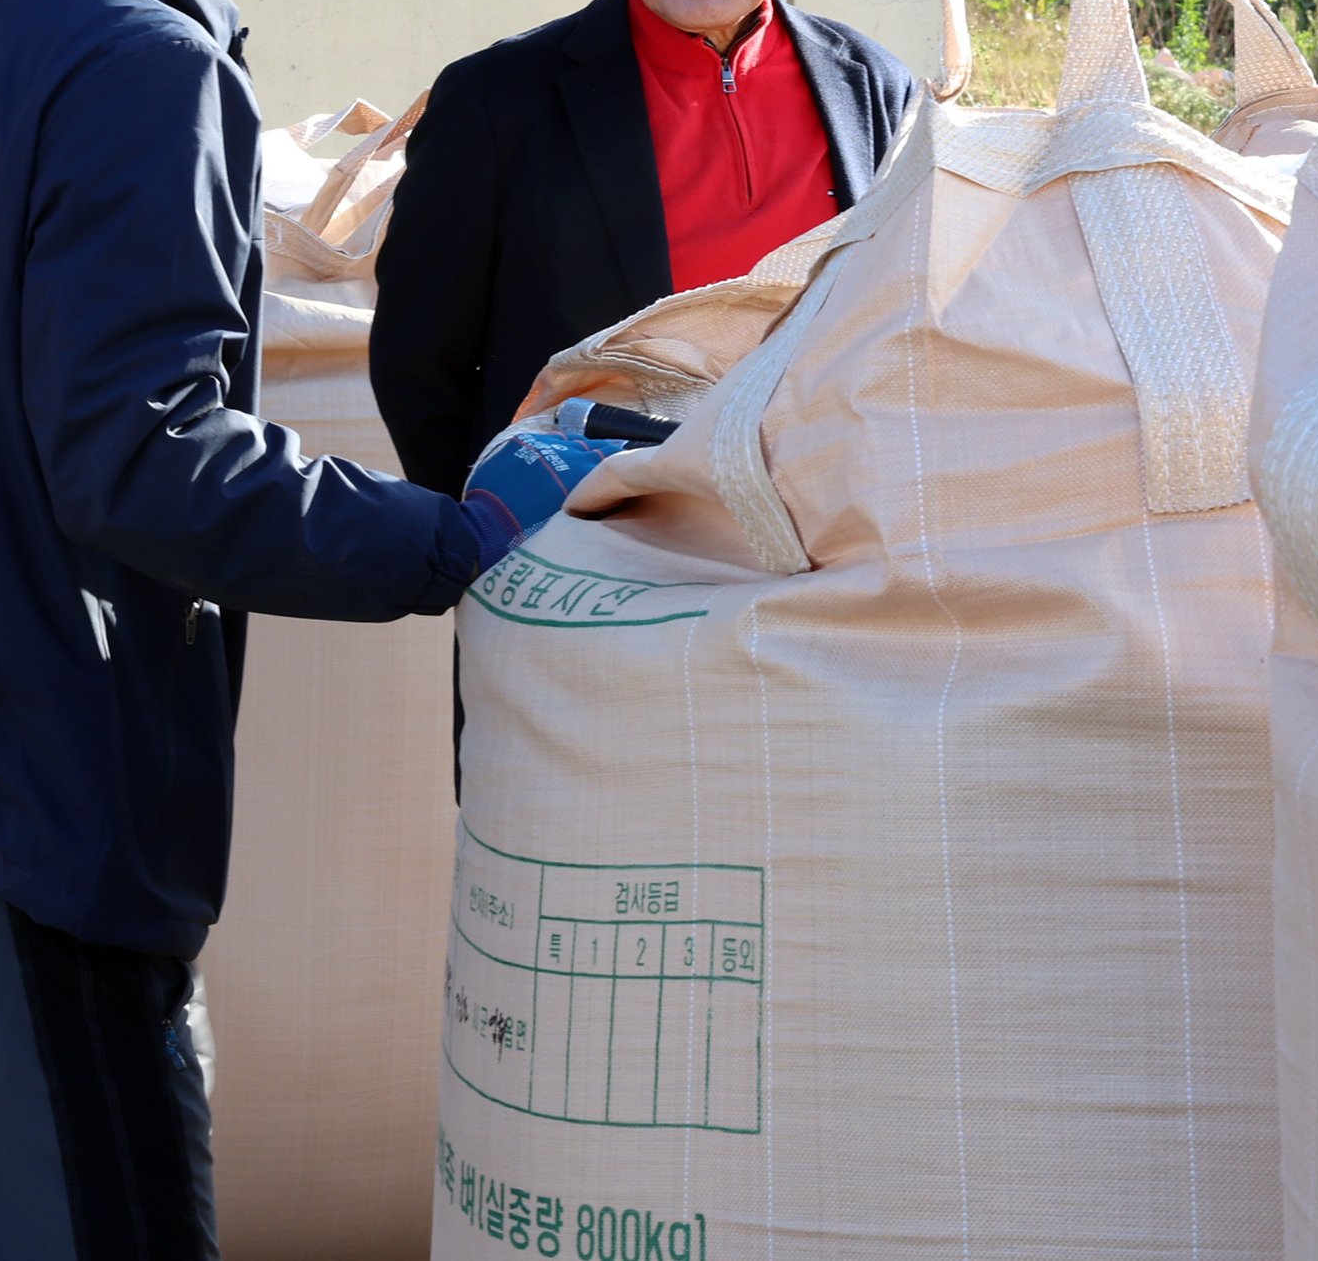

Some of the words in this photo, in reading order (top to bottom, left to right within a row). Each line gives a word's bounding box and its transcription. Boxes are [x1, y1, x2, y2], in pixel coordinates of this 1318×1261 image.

[483, 554, 651, 617] 중량표시선
[615, 880, 680, 915] 검사등급
[591, 937, 598, 966] 1
[635, 937, 647, 967] 2
[683, 936, 696, 967] 3
[722, 937, 756, 973] 등외
